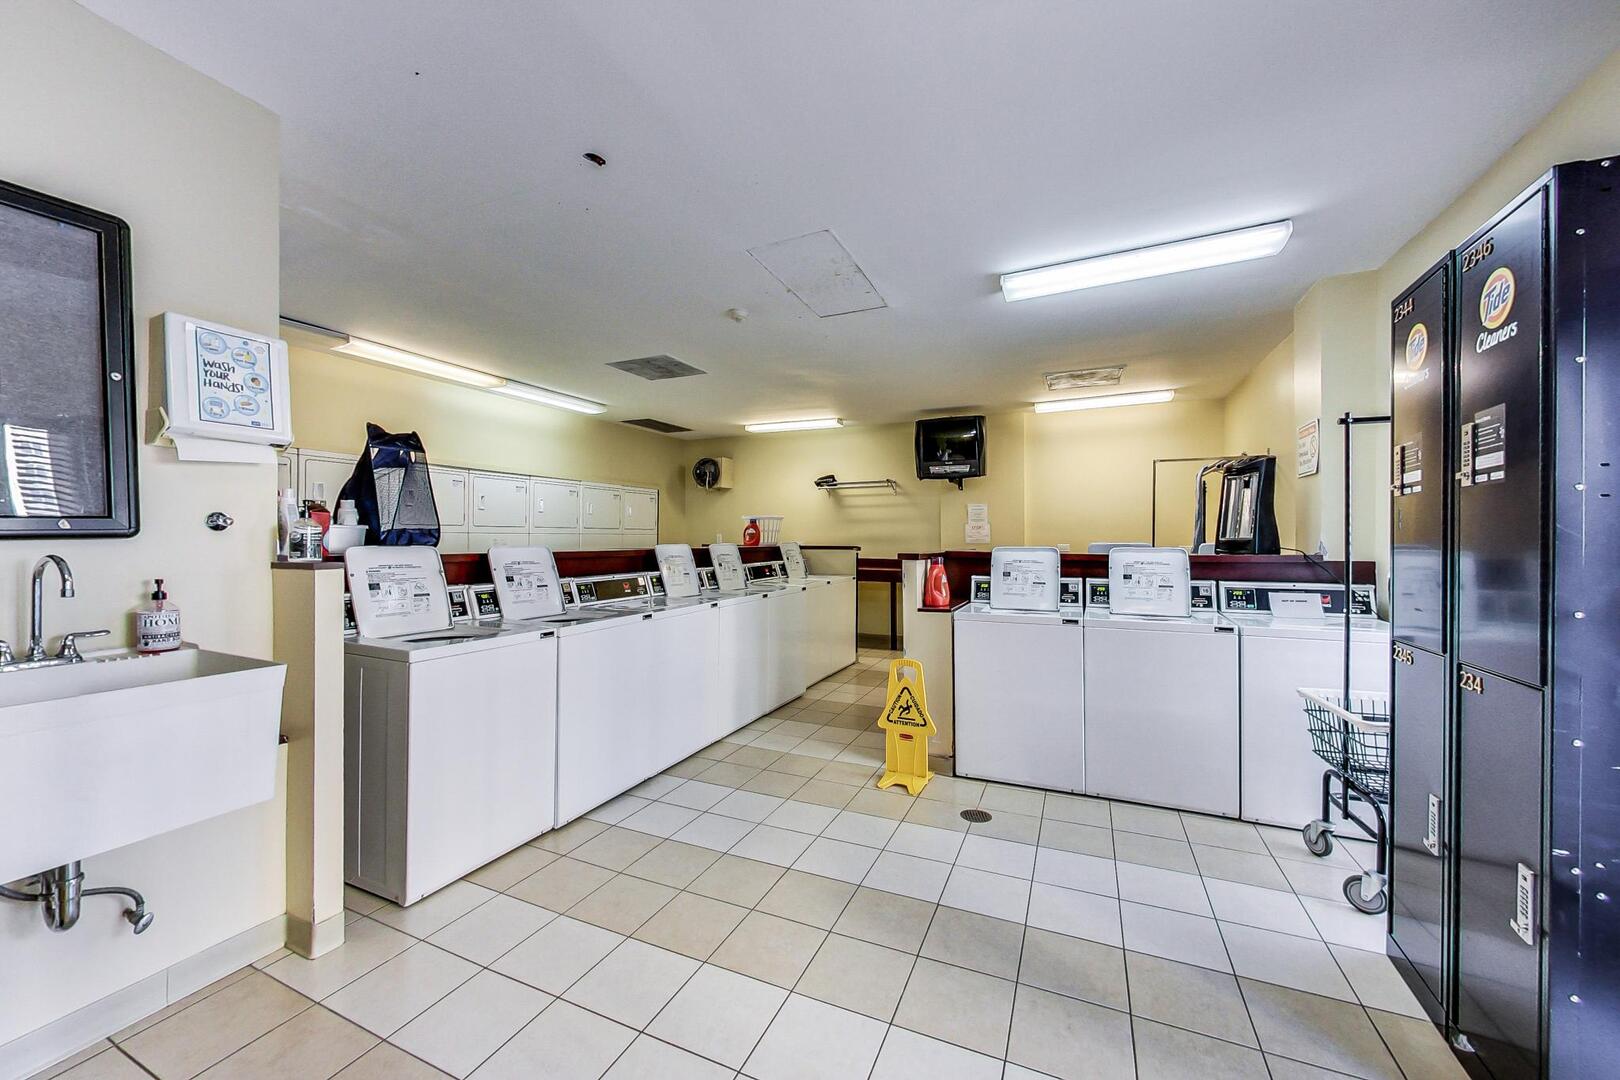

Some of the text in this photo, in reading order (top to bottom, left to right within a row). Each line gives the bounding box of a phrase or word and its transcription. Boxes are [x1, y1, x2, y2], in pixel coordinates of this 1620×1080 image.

[1462, 238, 1493, 272] 2346
[1394, 298, 1414, 323] 2344
[1482, 278, 1511, 325] Tide
[1476, 322, 1518, 353] Cleaners
[1460, 671, 1482, 694] 234
